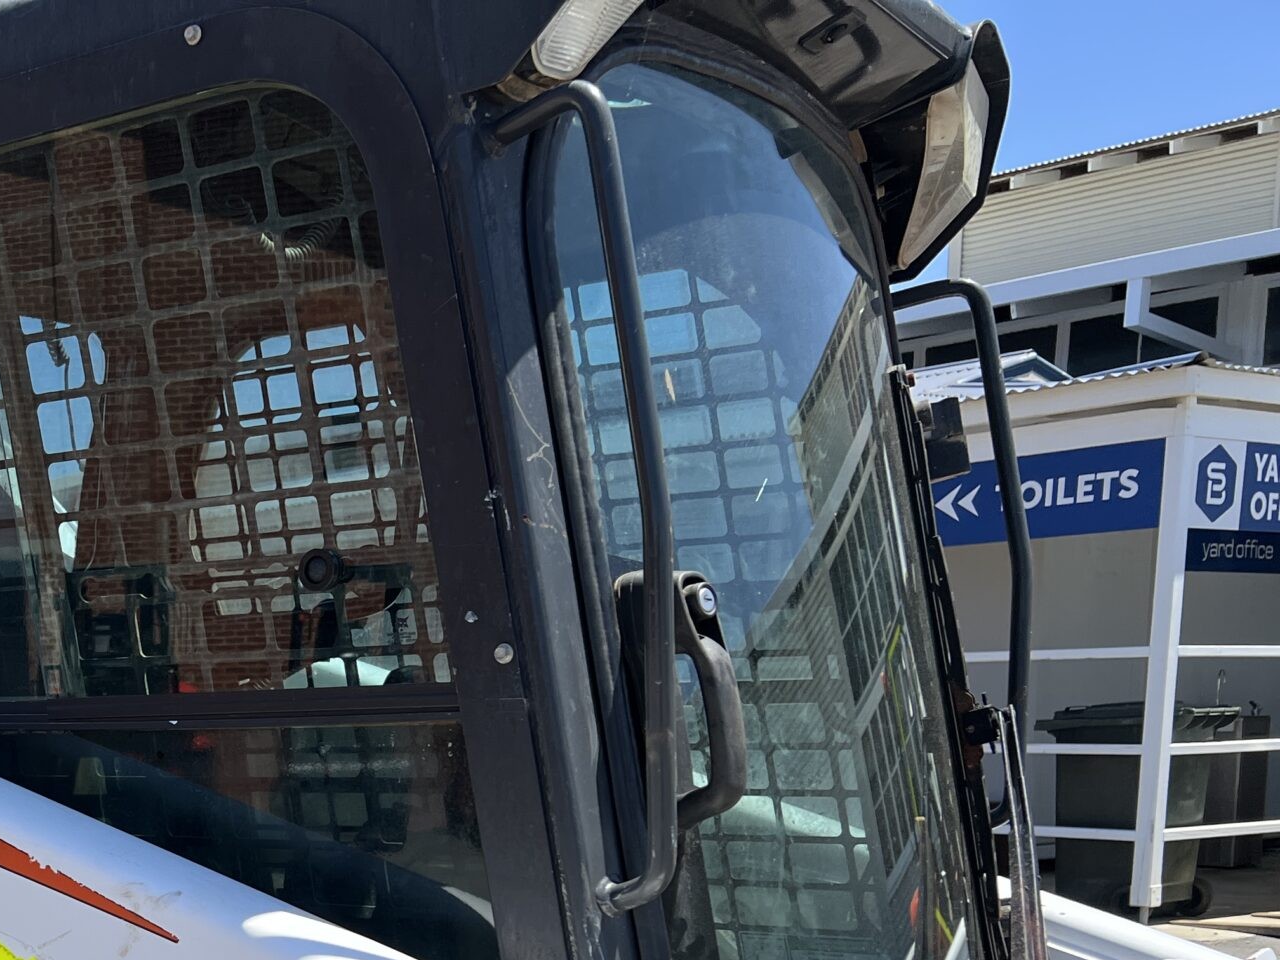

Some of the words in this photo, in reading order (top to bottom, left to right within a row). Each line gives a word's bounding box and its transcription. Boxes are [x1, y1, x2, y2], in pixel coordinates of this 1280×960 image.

[995, 469, 1140, 512] OILETS
[1202, 539, 1234, 561] yard
[1236, 539, 1274, 559] office
